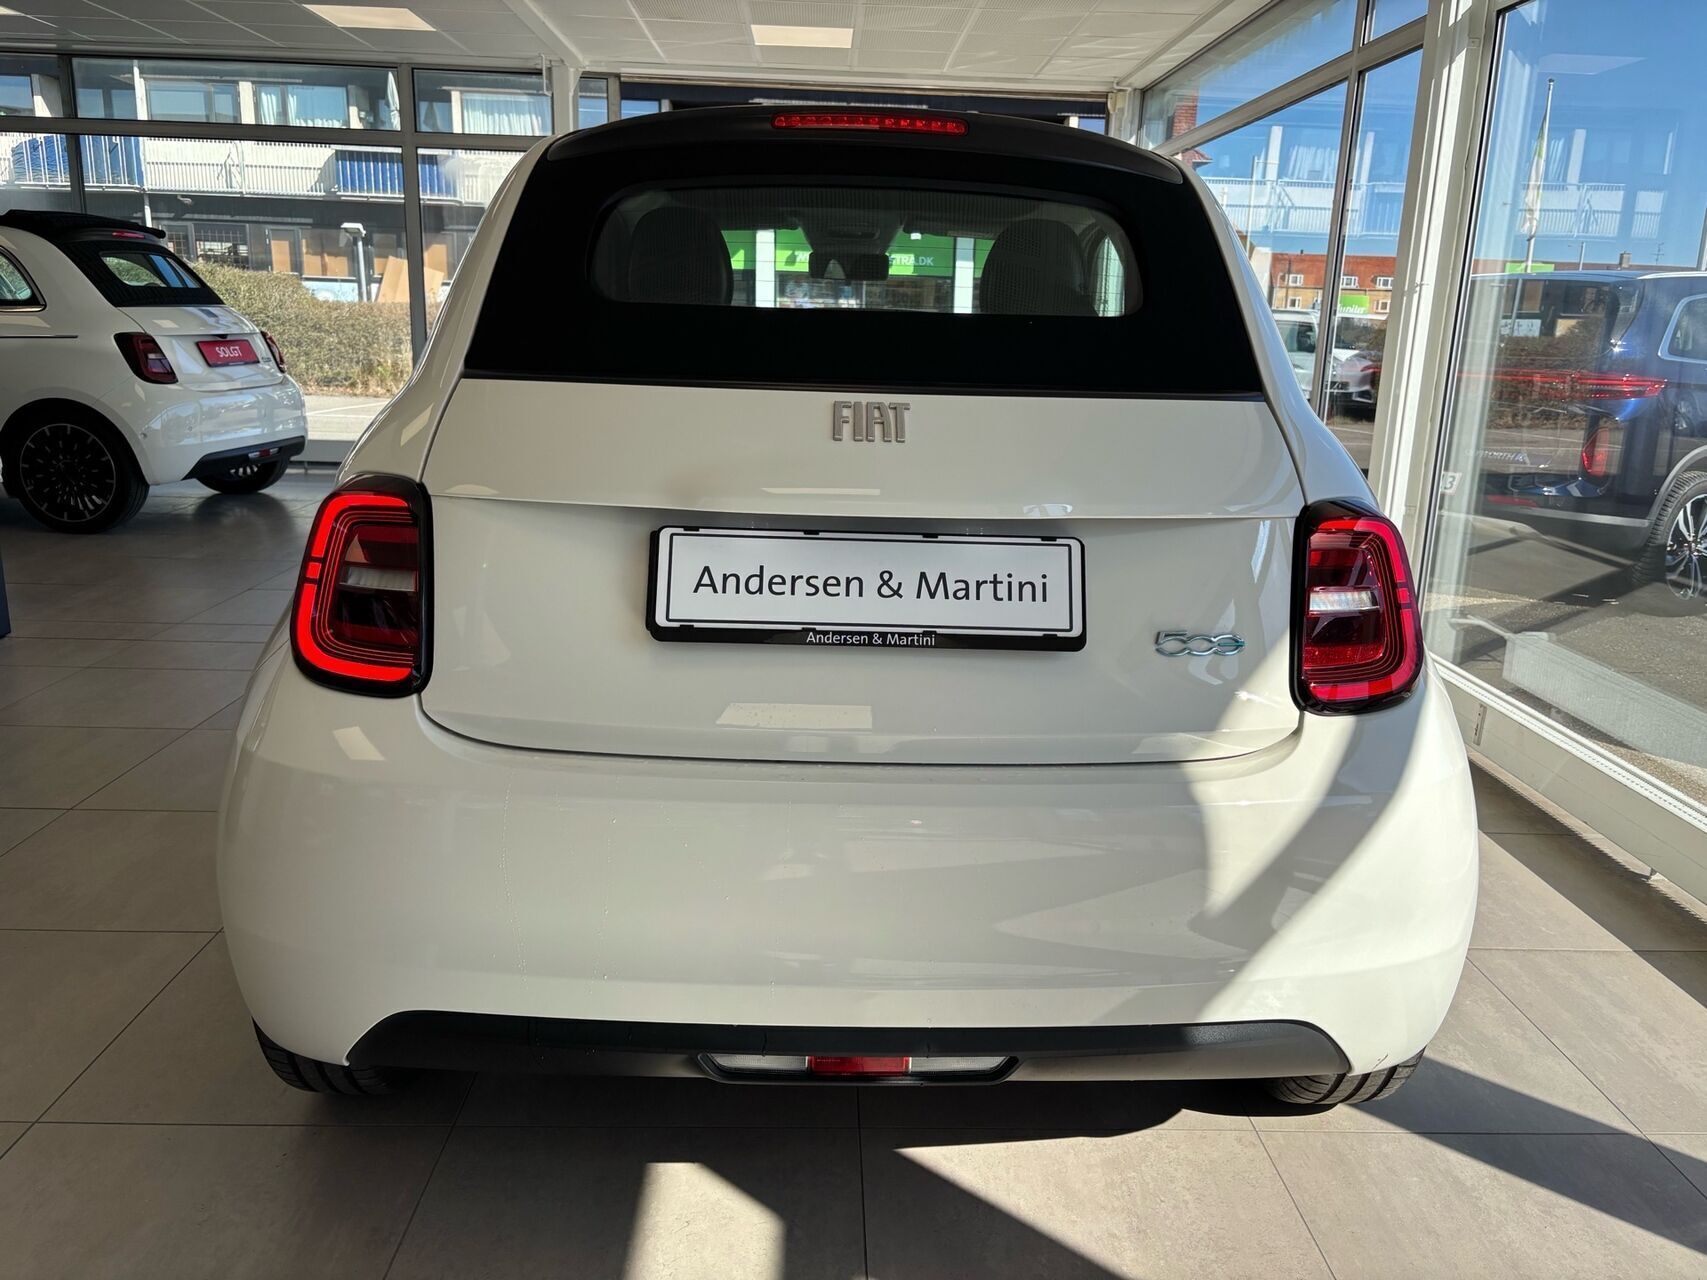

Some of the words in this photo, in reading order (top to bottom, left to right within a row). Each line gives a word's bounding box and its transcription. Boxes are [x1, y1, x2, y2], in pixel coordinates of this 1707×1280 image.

[215, 346, 242, 358] SOLGT
[831, 400, 910, 443] FIAT
[693, 564, 864, 598] Andersen
[876, 569, 904, 599] &
[916, 571, 1048, 603] Martini
[806, 631, 869, 645] Andersen
[872, 633, 883, 645] &
[886, 633, 935, 647] Martini
[1155, 630, 1246, 657] 500
